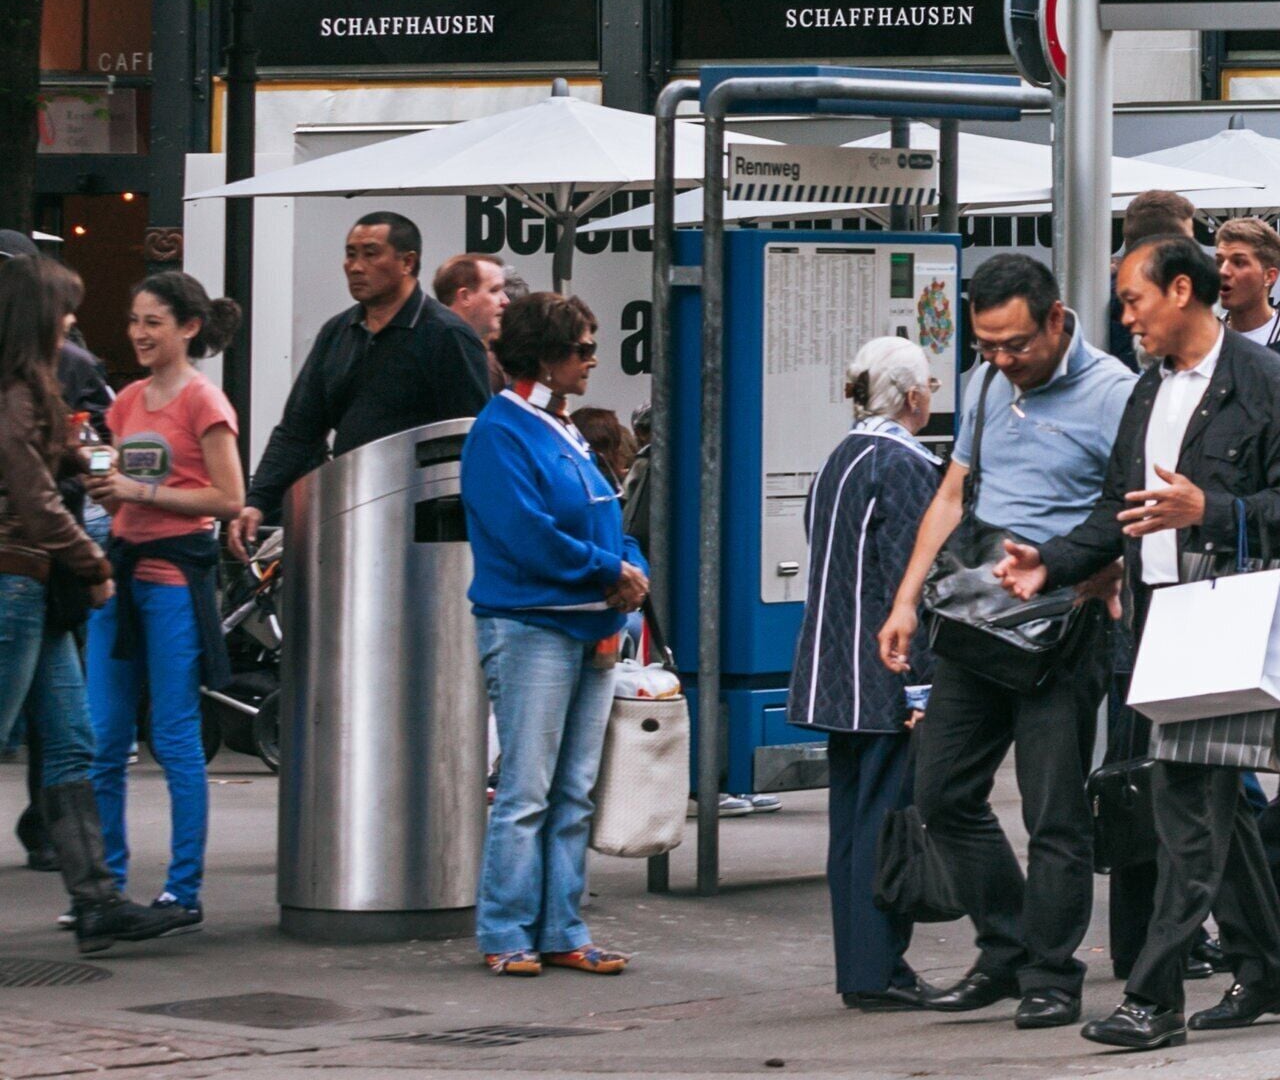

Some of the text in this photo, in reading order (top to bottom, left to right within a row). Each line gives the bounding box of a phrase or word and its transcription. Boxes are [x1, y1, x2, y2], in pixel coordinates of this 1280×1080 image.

[321, 15, 495, 37] SCHAFFHAUSEN
[786, 6, 974, 28] SCHAFFHAUSEN
[735, 156, 801, 182] Rennweg
